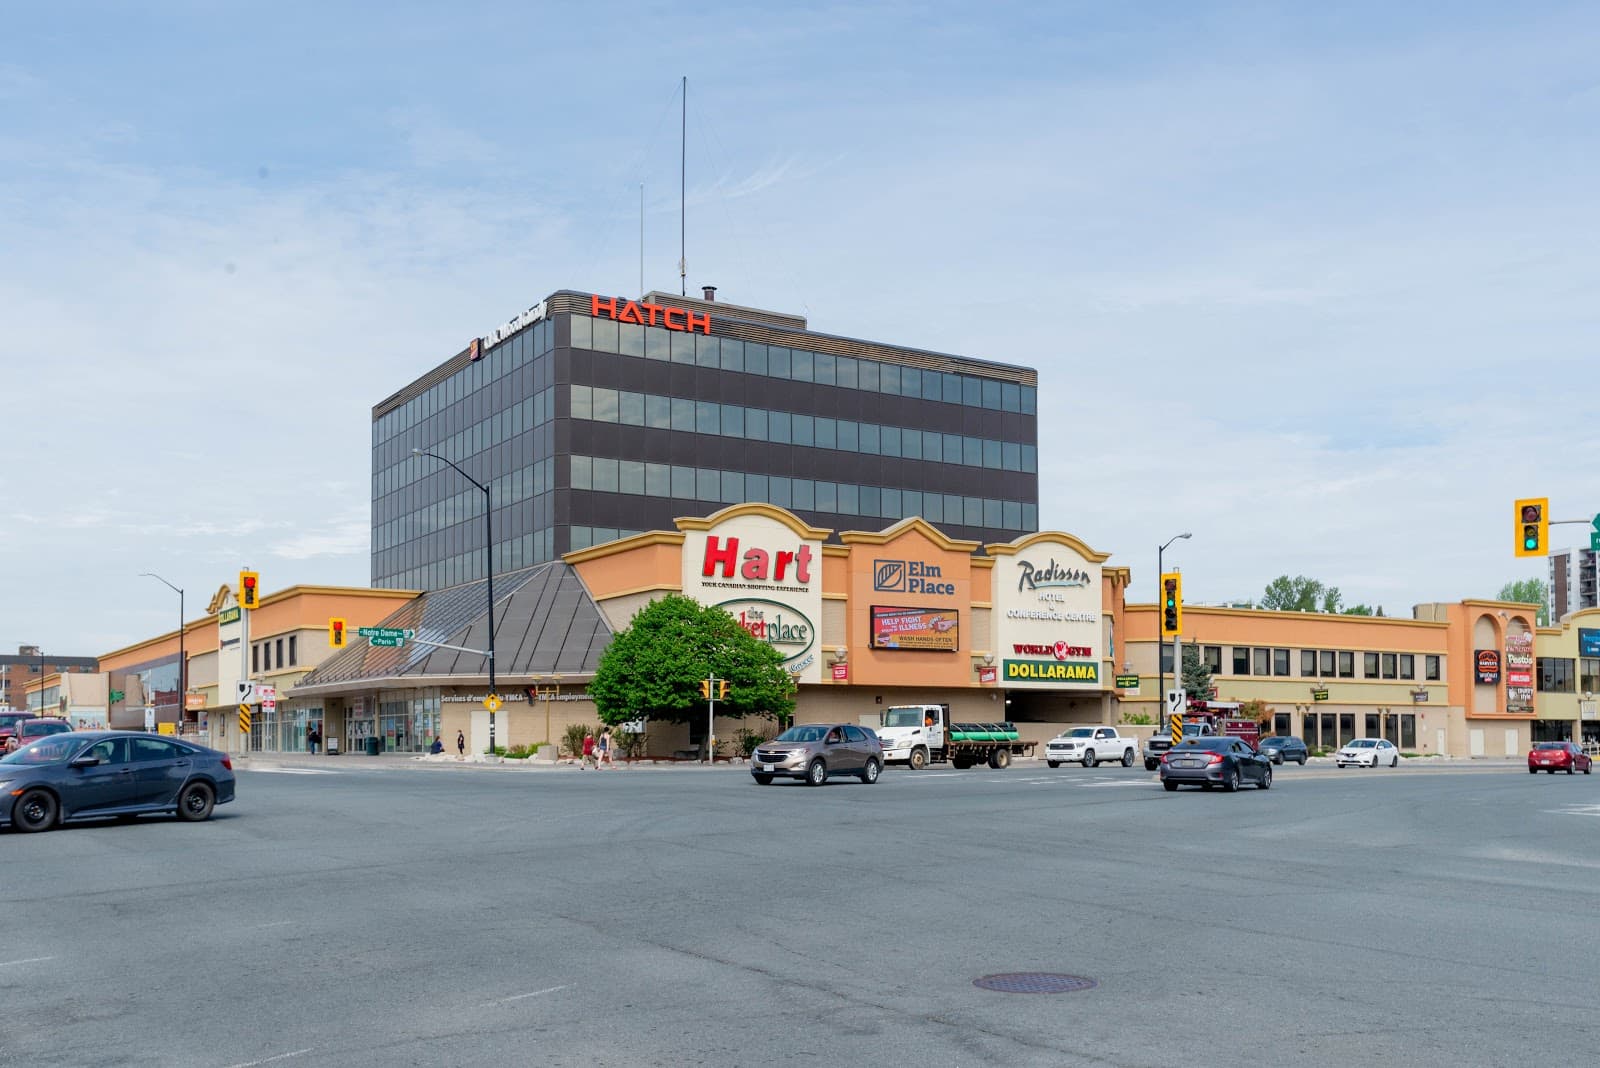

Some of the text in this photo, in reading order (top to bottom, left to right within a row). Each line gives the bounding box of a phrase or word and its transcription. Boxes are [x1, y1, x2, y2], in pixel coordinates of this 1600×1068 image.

[591, 294, 711, 335] HATCH
[702, 535, 812, 584] Hart
[908, 561, 942, 577] Elm
[1017, 558, 1091, 592] Radisson
[718, 582, 746, 590] CANADIAN
[908, 578, 955, 595] Place
[1038, 592, 1064, 602] HOTEL
[747, 607, 764, 619] the
[1007, 608, 1096, 623] CONFERENCE CENTRE
[380, 629, 398, 637] Dame
[1013, 644, 1092, 657] WORLD GYM
[1008, 663, 1096, 679] DOLLARAMA
[441, 694, 466, 702] Services
[505, 693, 523, 702] YMCA
